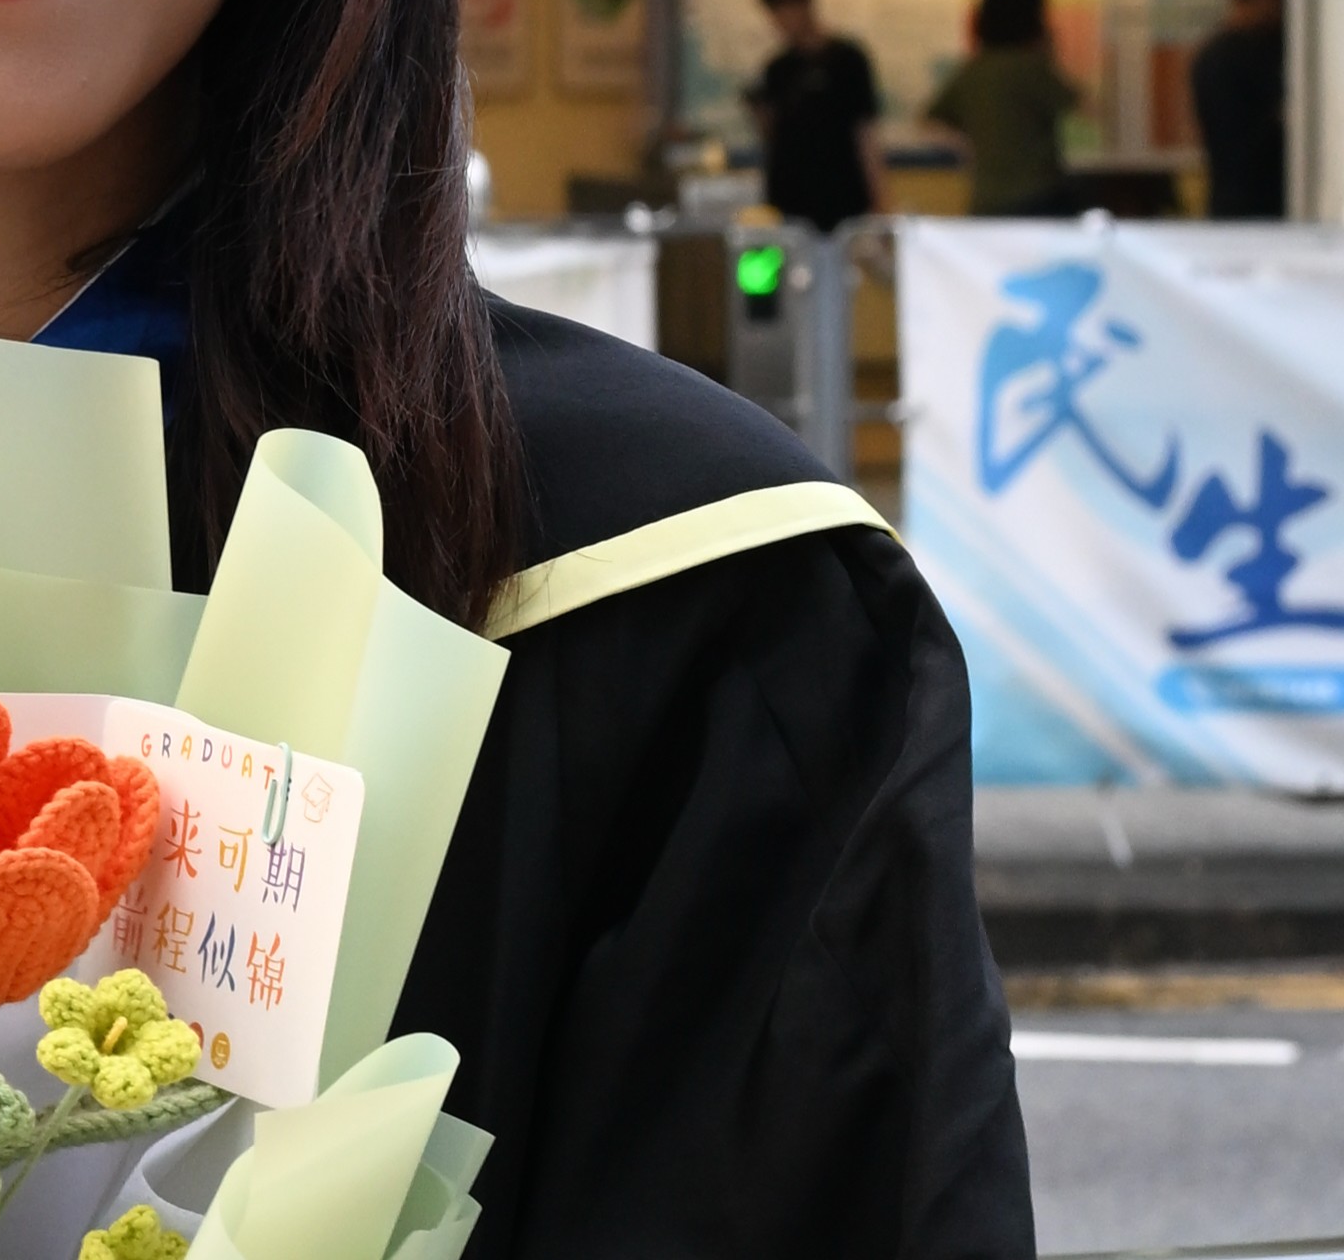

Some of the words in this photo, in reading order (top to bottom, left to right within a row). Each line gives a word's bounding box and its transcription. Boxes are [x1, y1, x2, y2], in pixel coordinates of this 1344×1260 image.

[976, 258, 1344, 650] 民生
[140, 732, 292, 802] GRADUAT
[150, 798, 306, 913] 来可期
[113, 884, 286, 1011] 前程似锦
